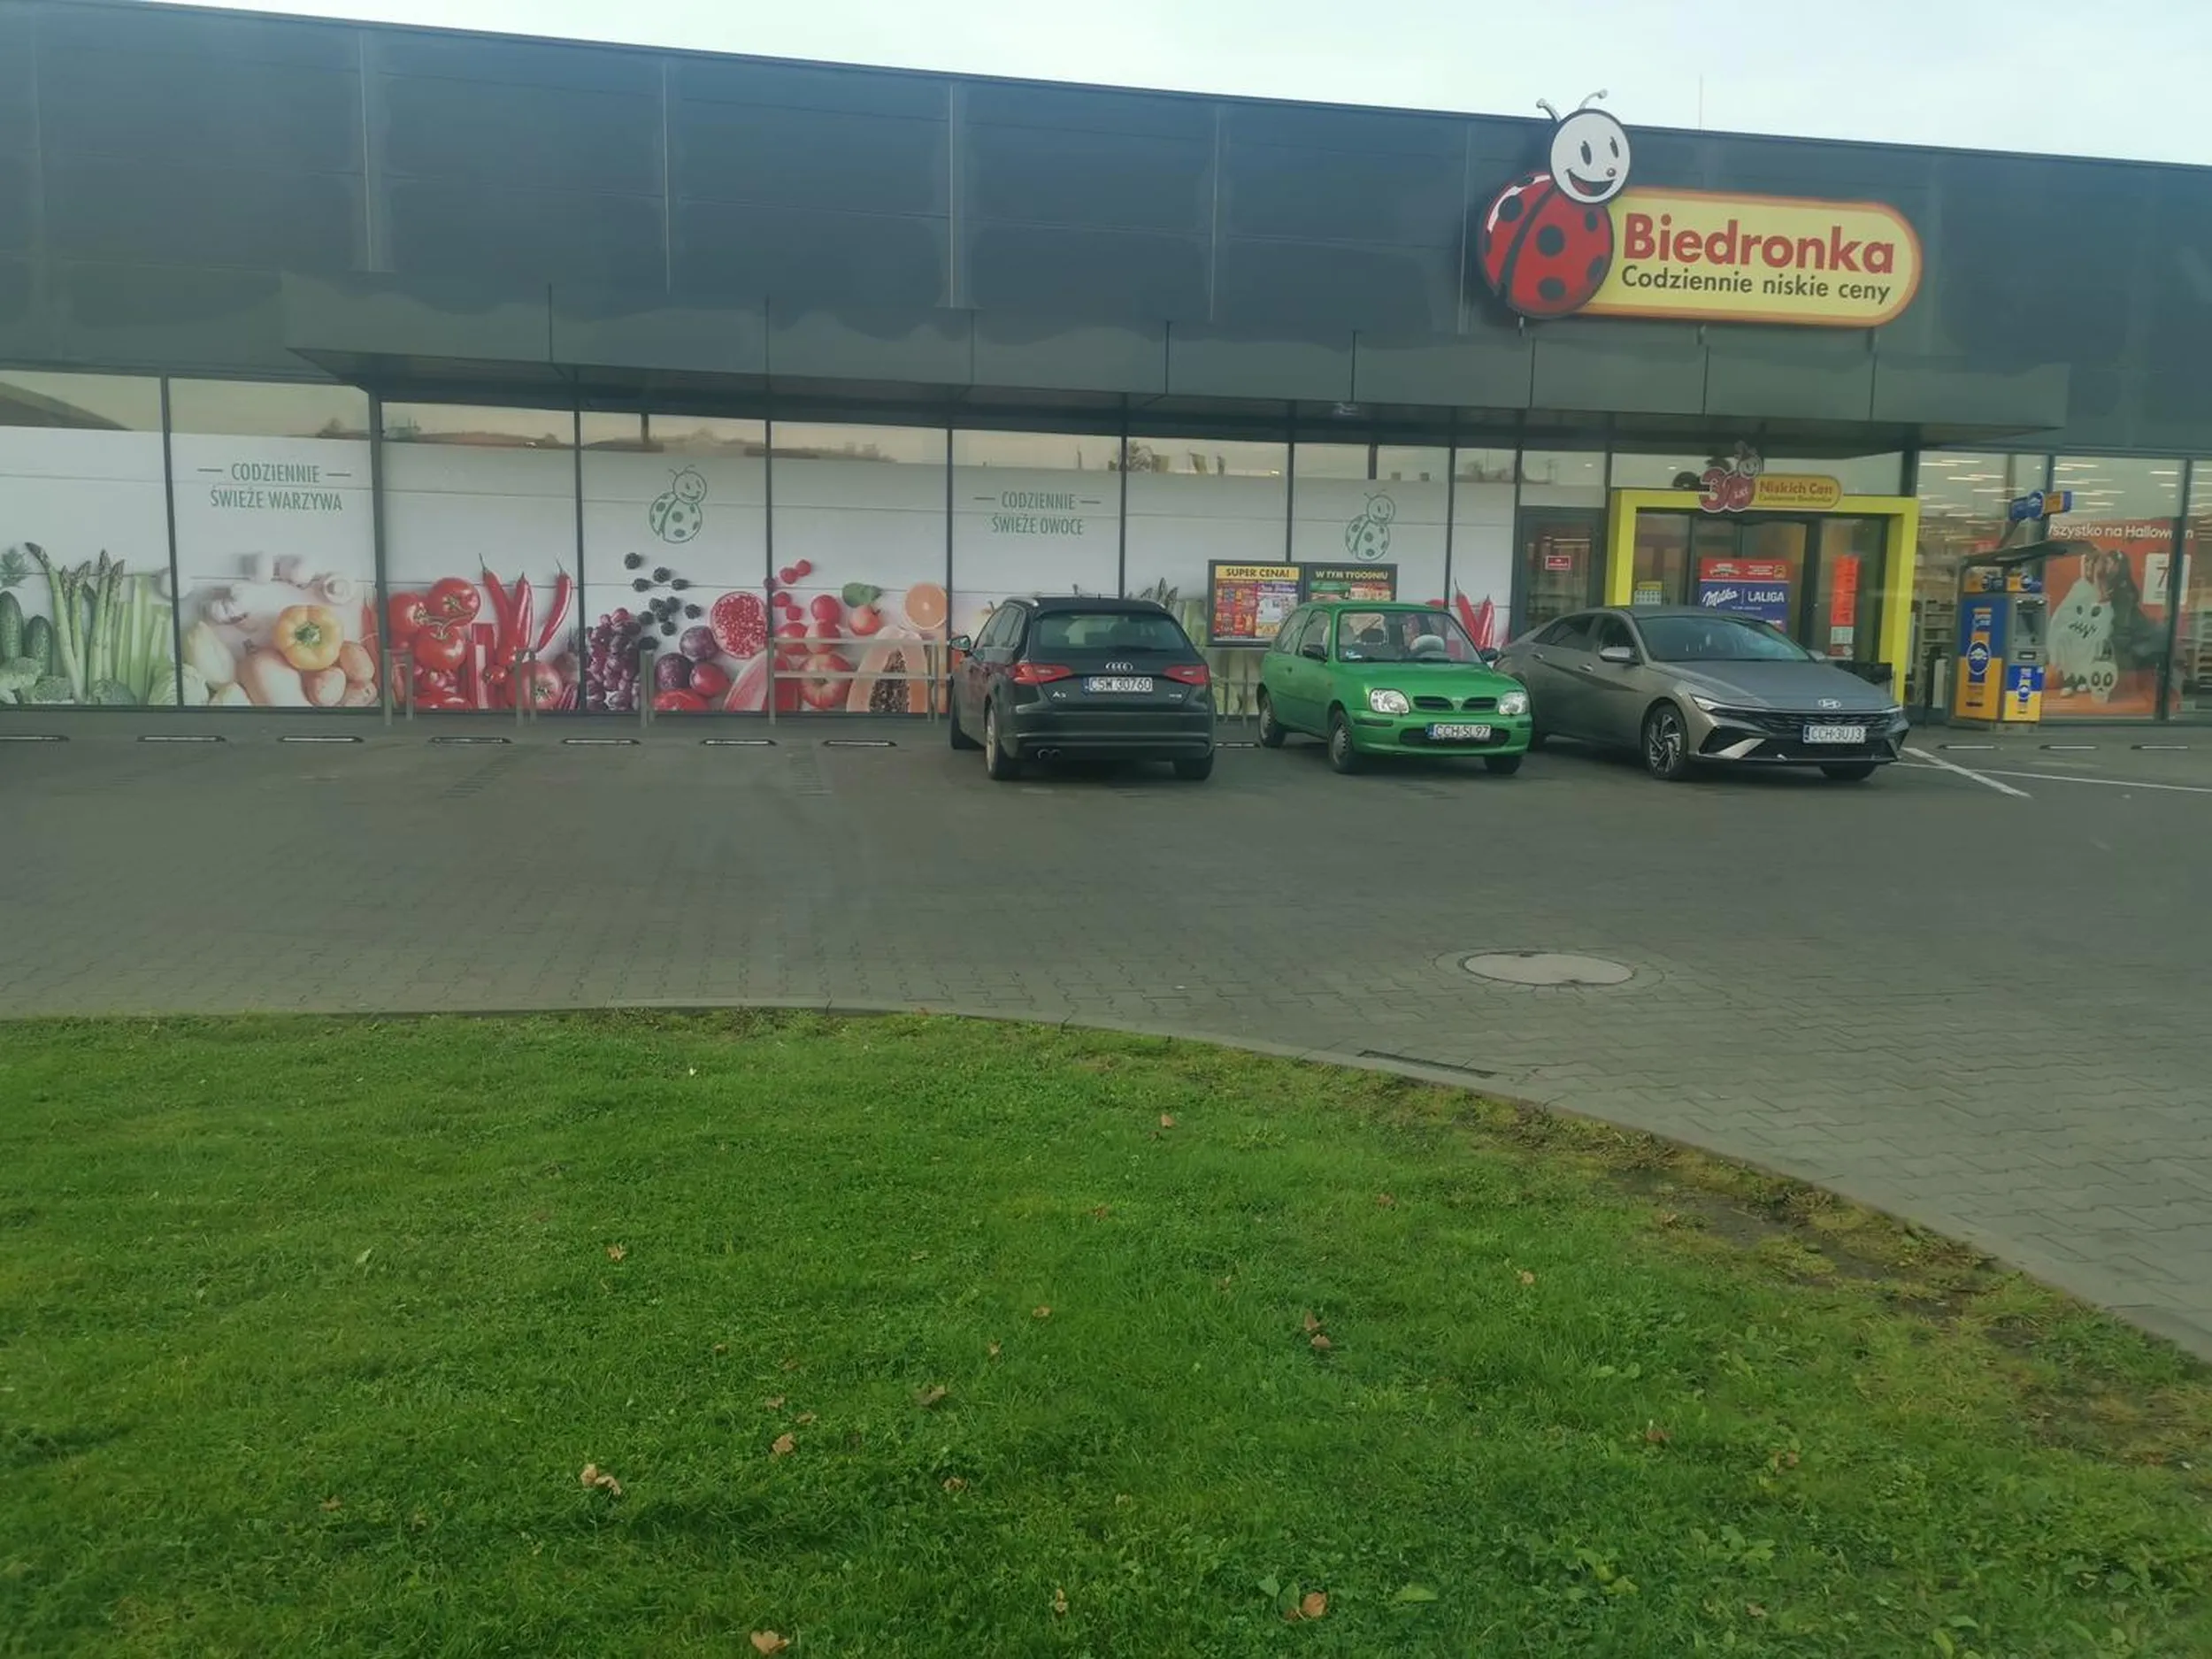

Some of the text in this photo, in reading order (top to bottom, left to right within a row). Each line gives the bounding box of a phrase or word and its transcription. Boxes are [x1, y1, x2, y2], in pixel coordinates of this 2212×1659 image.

[1624, 212, 1894, 274] Biedronka
[1622, 265, 1891, 304] Codziennie niskie ceny
[231, 463, 320, 483] CODZIENNIE
[211, 486, 342, 511] ŚWIEŻE WARZYWA
[1002, 491, 1076, 510] CODZIENNIE
[992, 512, 1083, 534] ŚWIEŻE OWOCE
[2125, 526, 2194, 539] Hallown
[1226, 567, 1289, 578] SUPER CENA!
[1701, 588, 1786, 607] Milka LALIGA
